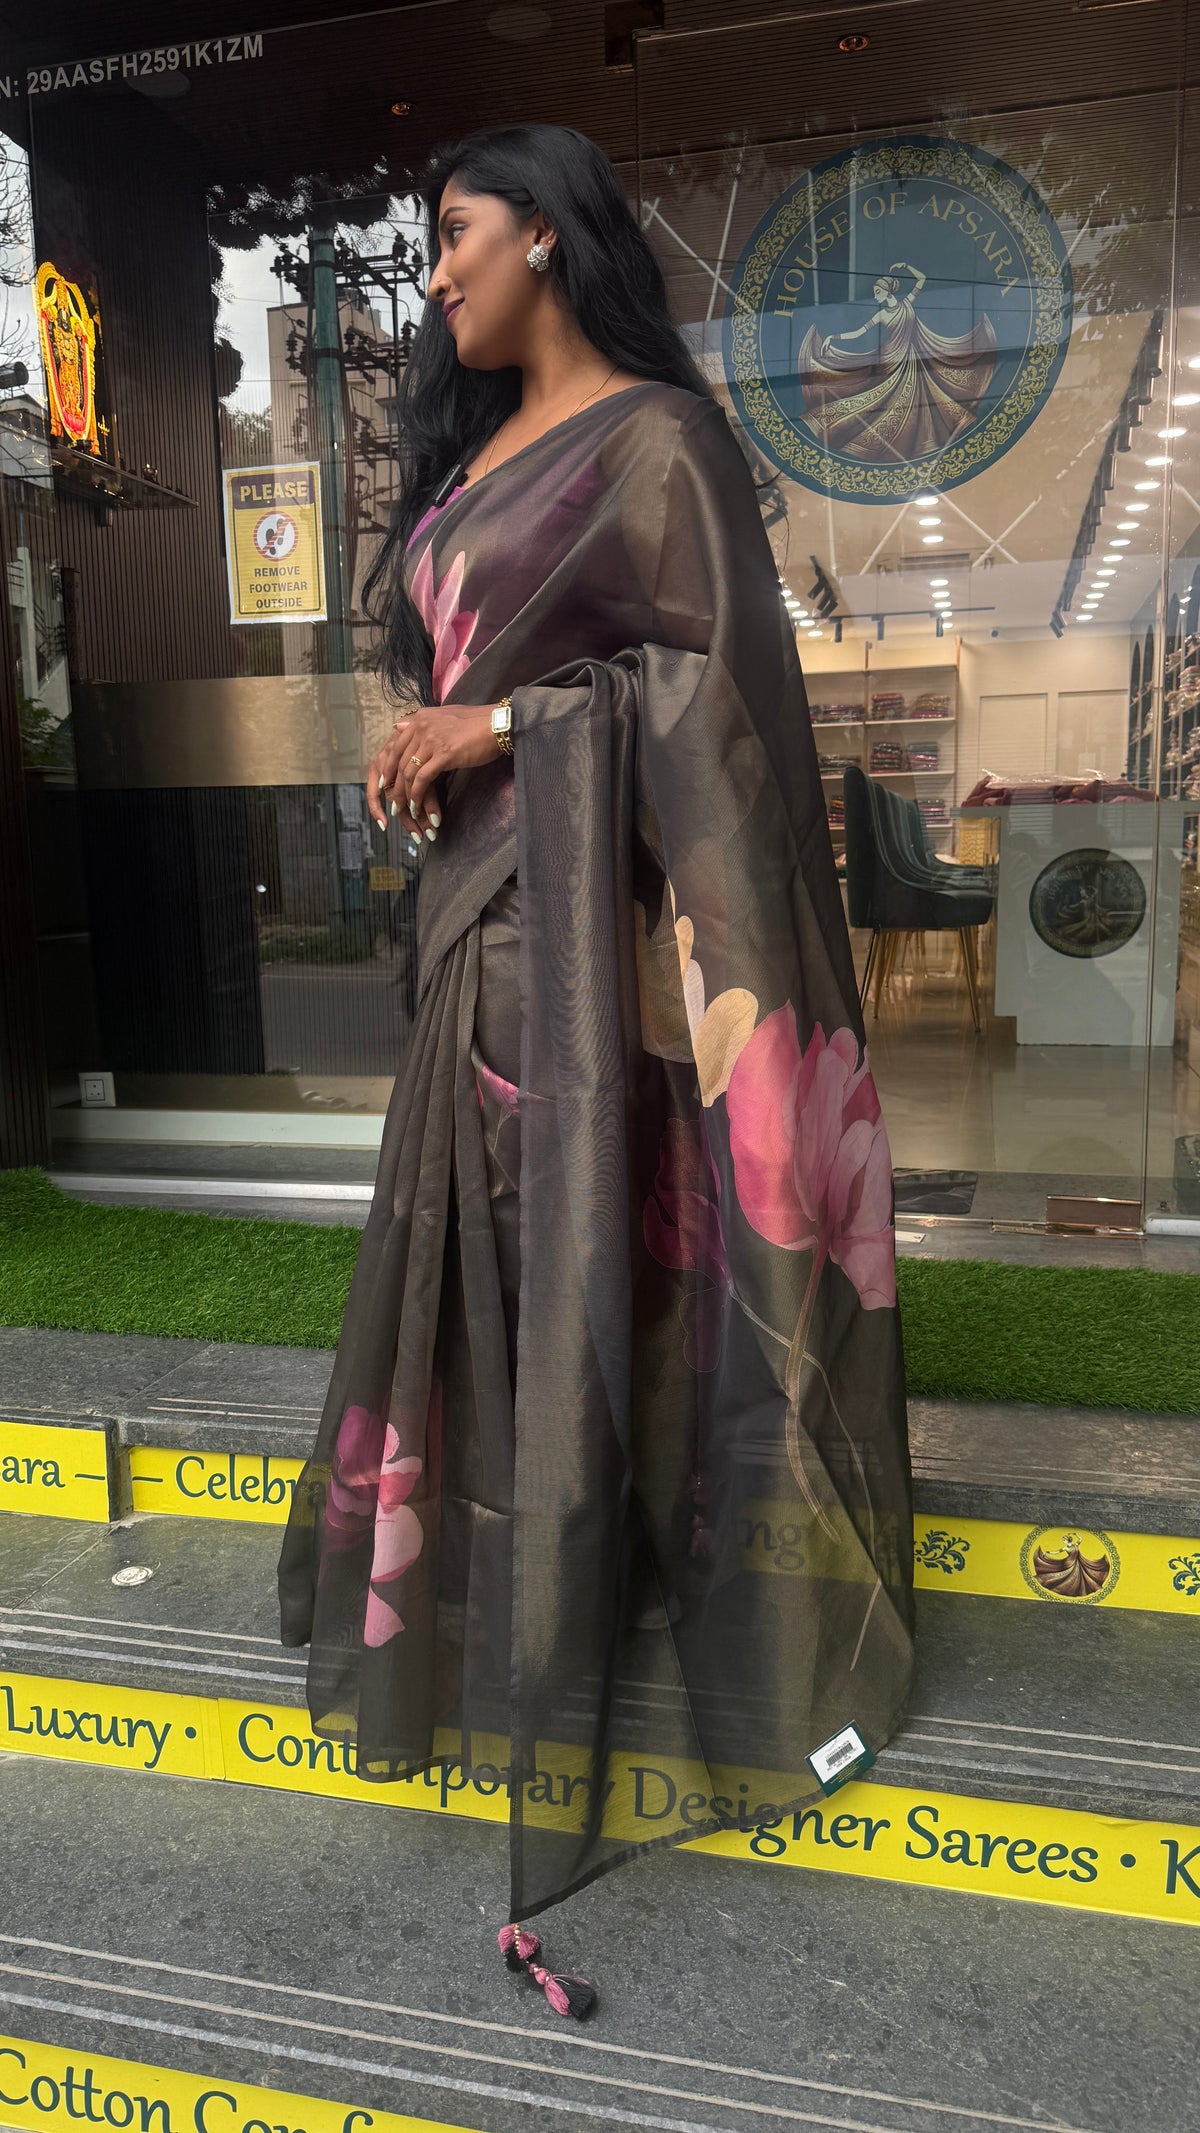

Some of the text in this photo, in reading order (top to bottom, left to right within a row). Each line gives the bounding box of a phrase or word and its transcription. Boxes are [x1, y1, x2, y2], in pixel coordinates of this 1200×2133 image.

[27, 35, 263, 95] 29AASFH2591K1ZM
[774, 191, 1020, 318] HOUSE OF APSARA
[240, 480, 308, 503] PLEASE
[249, 580, 308, 594] FOOTWEAR
[254, 565, 301, 578] REMOVE
[256, 596, 303, 609] OUTSIDE
[0, 1685, 172, 1769] Luxury
[628, 1766, 891, 1858] Designer
[905, 1805, 1099, 1883] Sarees
[0, 2047, 178, 2133] Cotton
